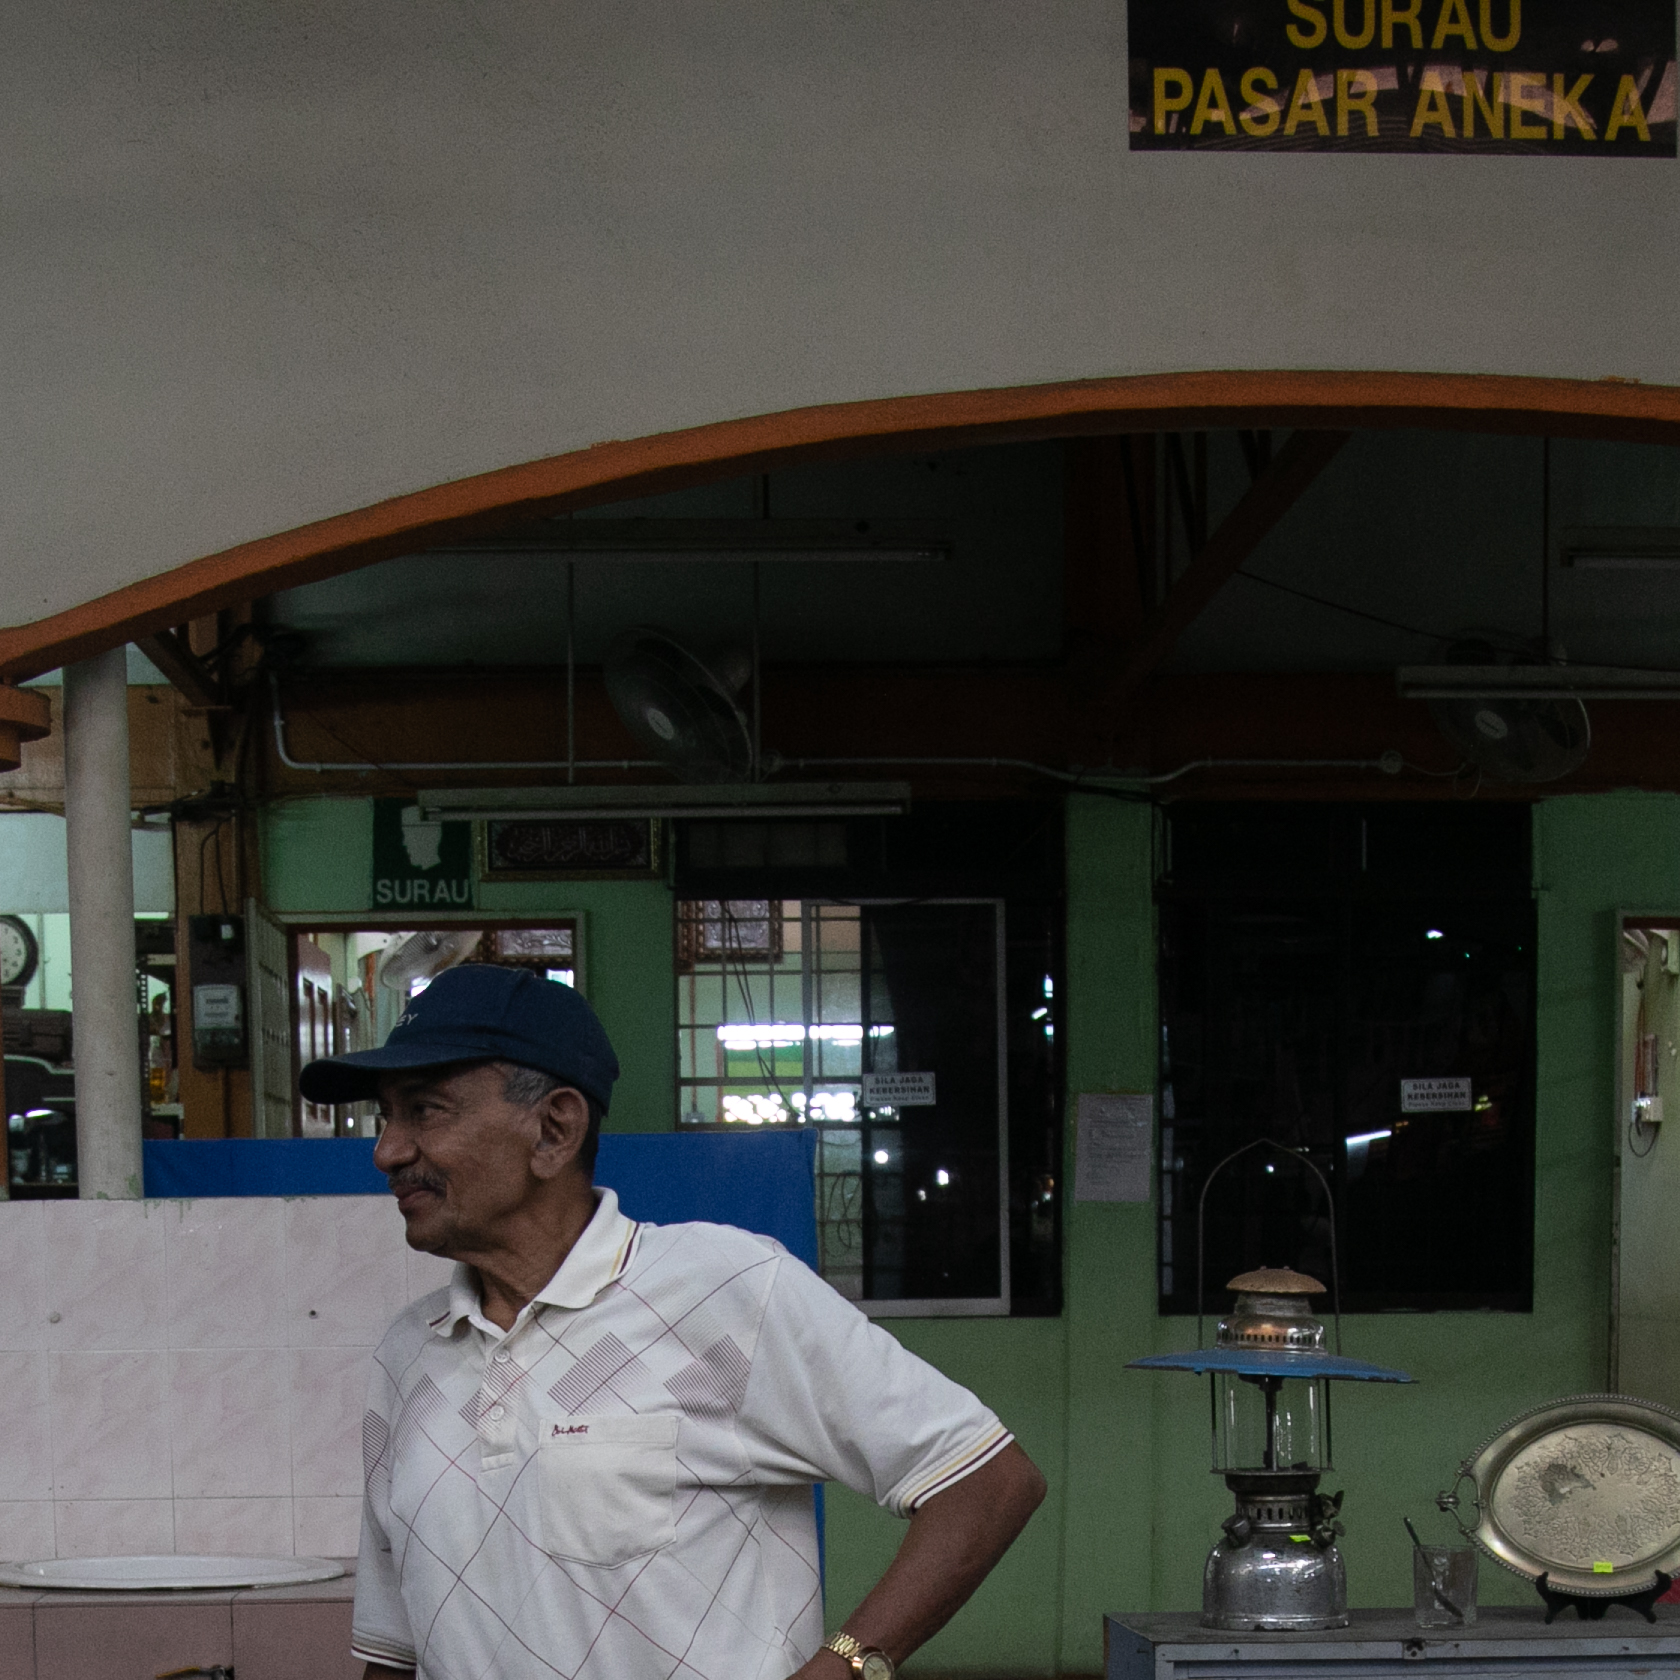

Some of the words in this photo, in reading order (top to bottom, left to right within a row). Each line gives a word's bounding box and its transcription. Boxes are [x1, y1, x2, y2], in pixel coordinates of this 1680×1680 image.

[1286, 0, 1522, 52] SURAU
[1153, 67, 1380, 137] PASAR
[1409, 70, 1650, 143] ANEKA
[376, 878, 469, 906] SURAU
